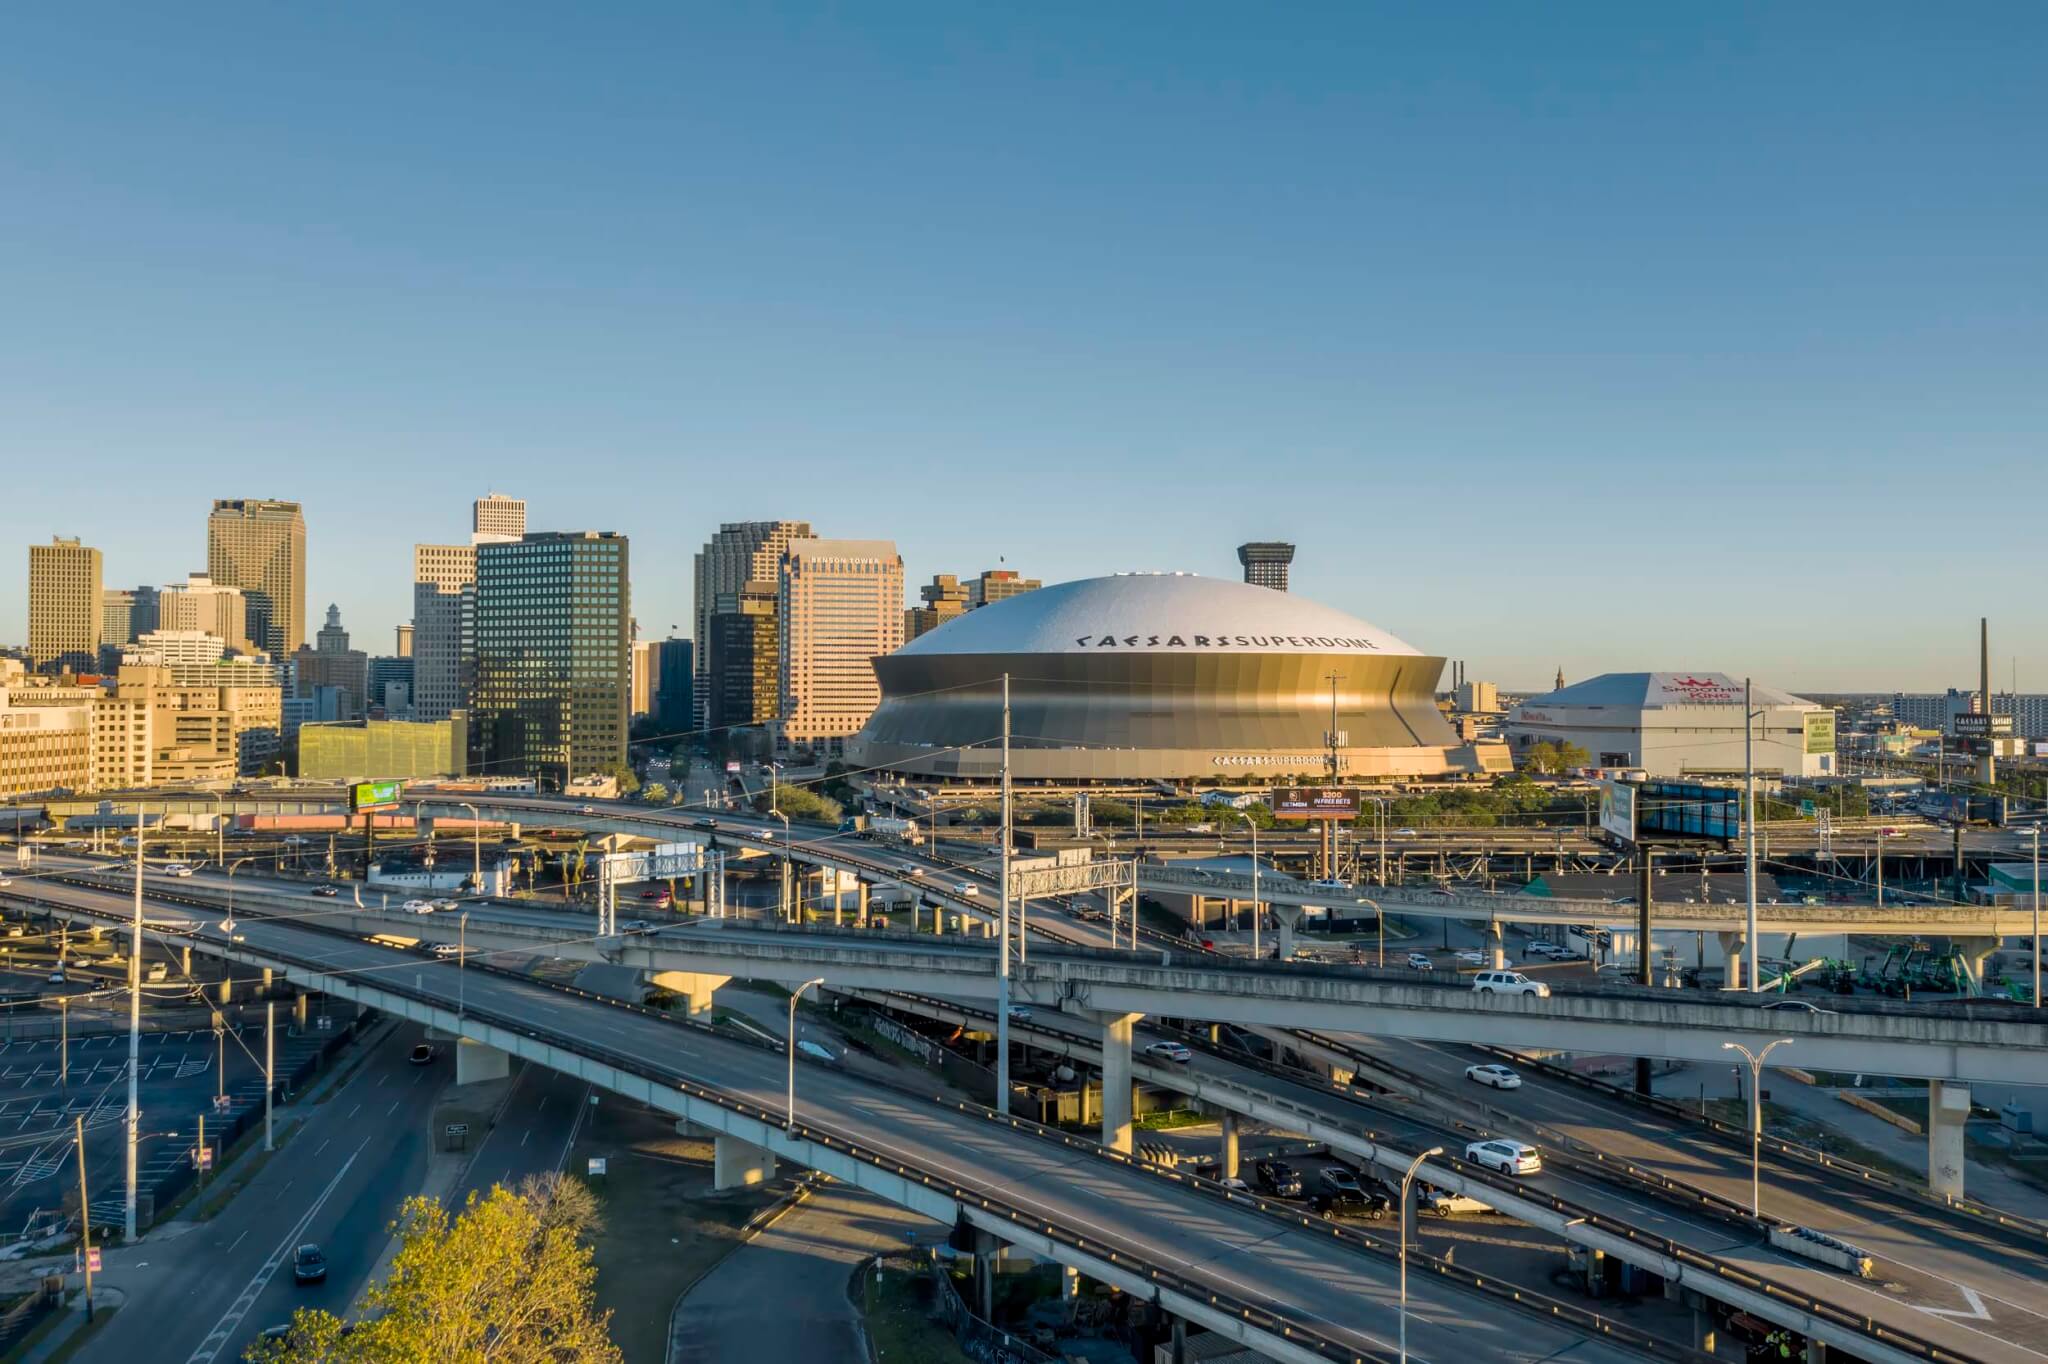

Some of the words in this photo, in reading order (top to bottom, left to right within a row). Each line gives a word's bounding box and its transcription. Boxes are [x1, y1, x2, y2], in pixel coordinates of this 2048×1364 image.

[1076, 635, 1230, 647] CAESARS
[1235, 635, 1380, 649] SUPERDOME
[1956, 717, 1988, 725] CAESARS
[1212, 756, 1270, 766] CAESARS
[1271, 756, 1325, 766] SUPERDOM
